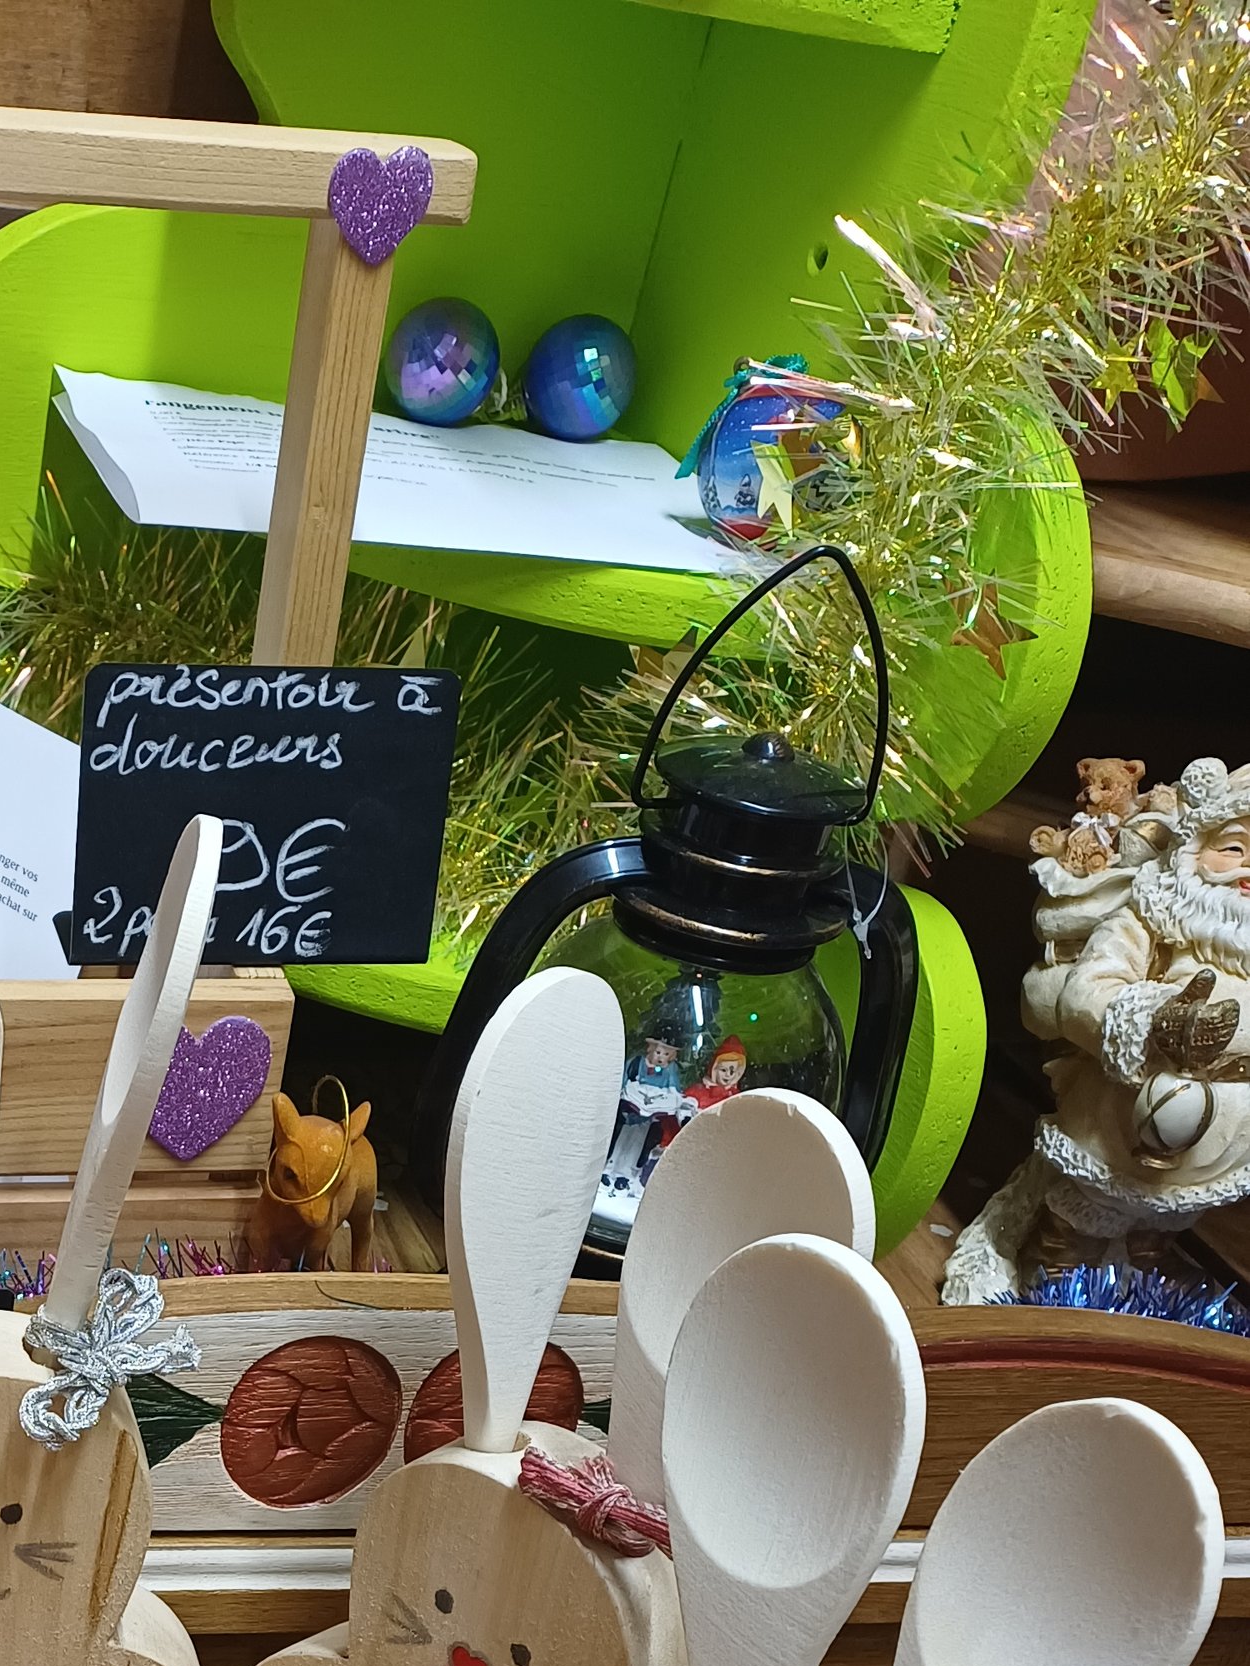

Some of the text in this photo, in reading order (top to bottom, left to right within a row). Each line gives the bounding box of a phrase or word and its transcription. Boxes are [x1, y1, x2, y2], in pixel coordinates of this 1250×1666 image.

[96, 664, 376, 728] présentoir
[89, 712, 345, 776] douceurs
[1, 875, 30, 898] même
[22, 866, 39, 883] vos
[23, 908, 38, 922] sur
[83, 886, 123, 944] 2
[236, 904, 333, 958] 16€
